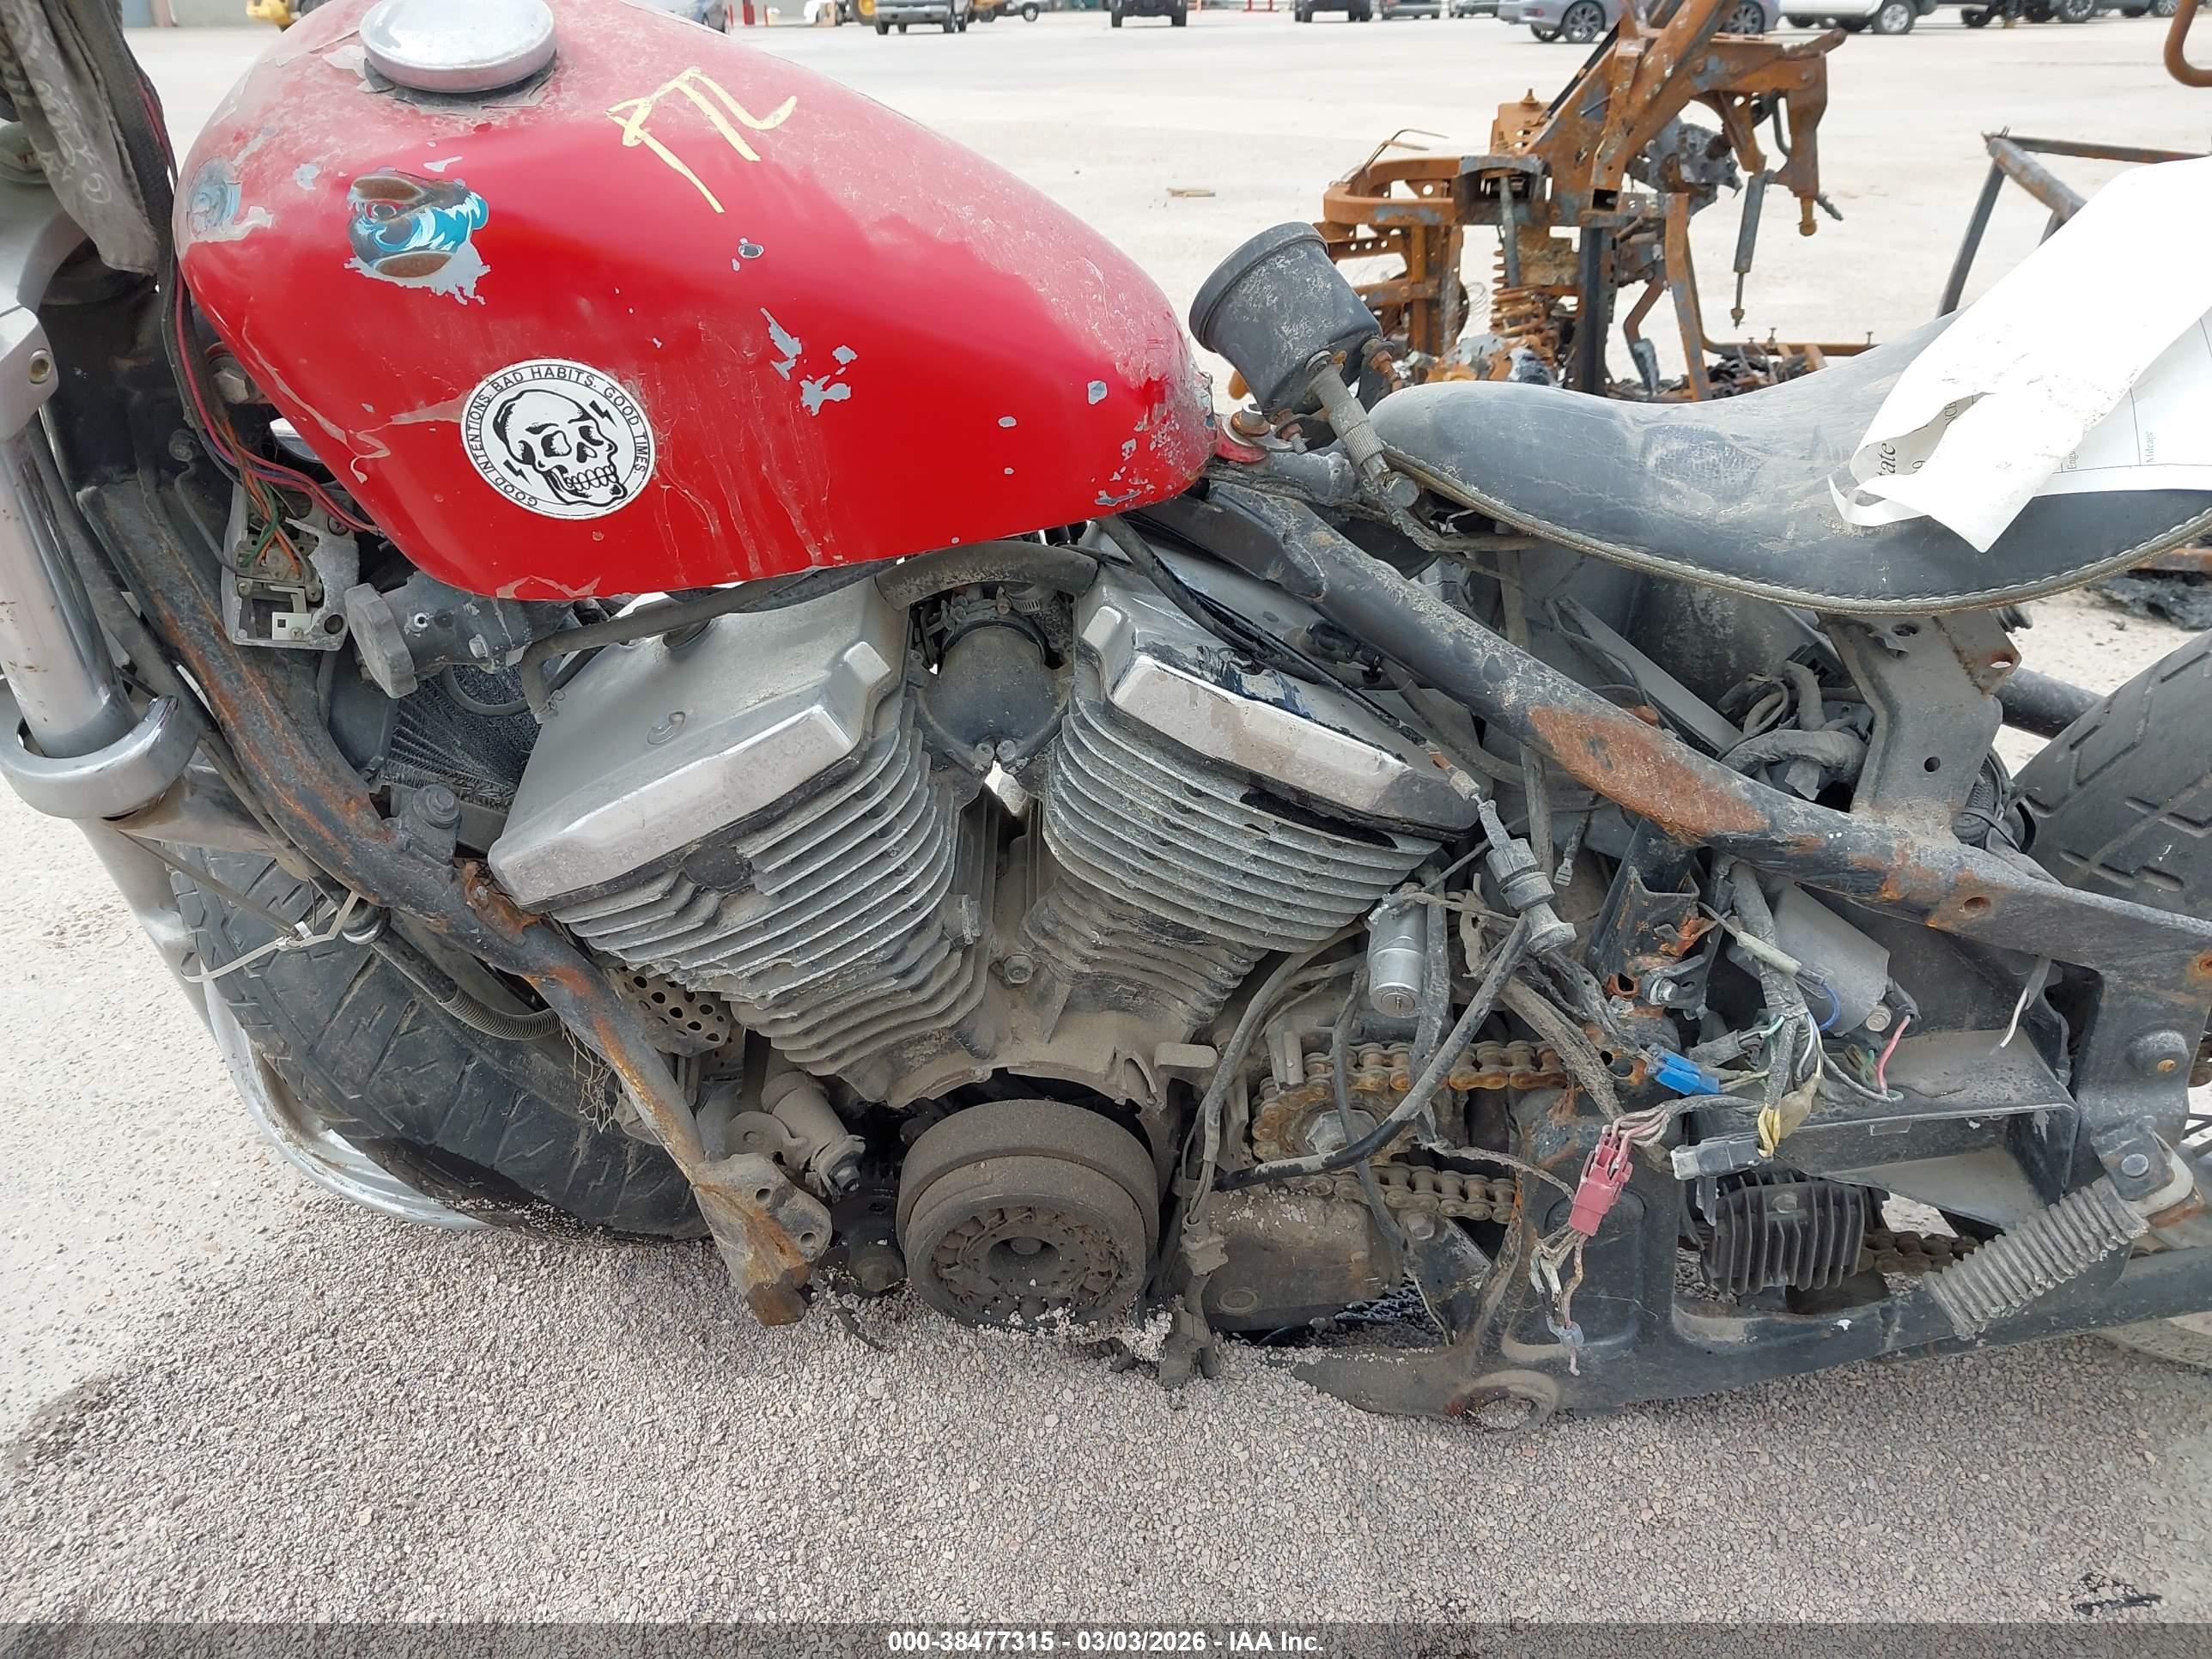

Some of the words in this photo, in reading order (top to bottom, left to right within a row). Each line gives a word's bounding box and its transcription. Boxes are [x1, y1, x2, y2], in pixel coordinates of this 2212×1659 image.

[490, 371, 525, 392] BAD
[530, 366, 597, 389] HABITS.
[604, 387, 640, 427] GOOD
[468, 393, 495, 474] INTENTIONS.
[634, 432, 649, 474] TIMES.
[494, 476, 538, 507] GOOD
